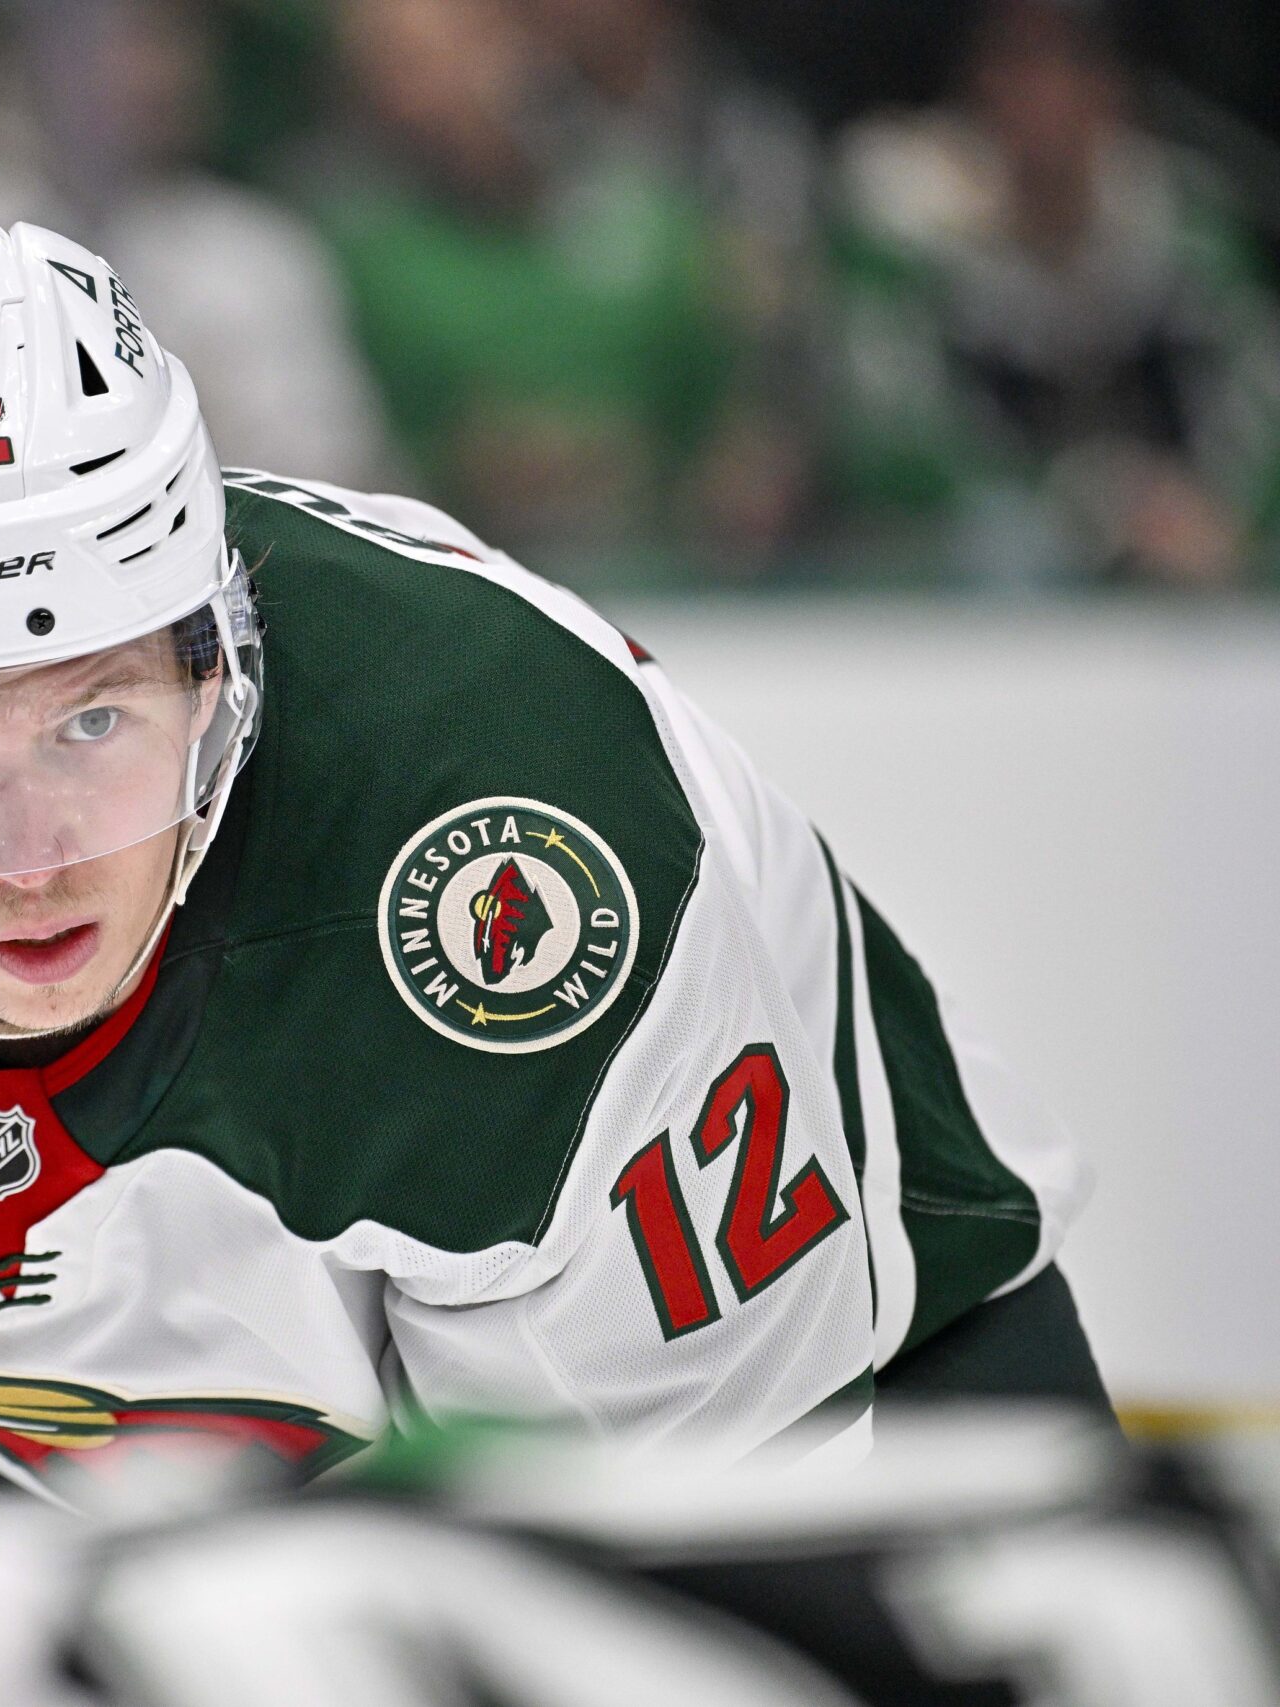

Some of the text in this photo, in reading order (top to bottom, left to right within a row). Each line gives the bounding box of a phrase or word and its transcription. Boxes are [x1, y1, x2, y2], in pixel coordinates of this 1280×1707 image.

[399, 815, 522, 1008] MINNESOTA
[552, 907, 620, 1009] WILD
[609, 1042, 851, 1343] 12
